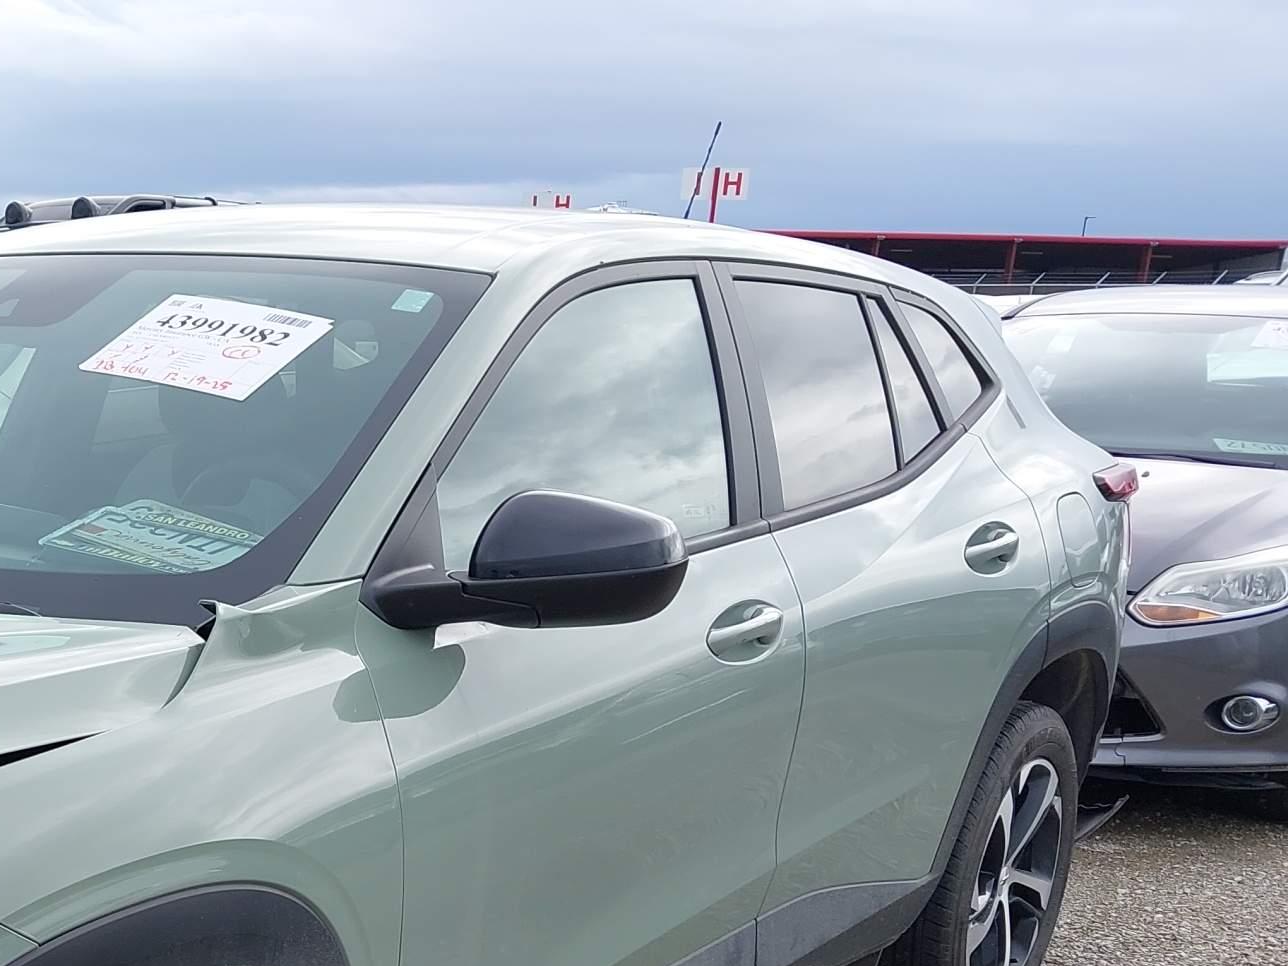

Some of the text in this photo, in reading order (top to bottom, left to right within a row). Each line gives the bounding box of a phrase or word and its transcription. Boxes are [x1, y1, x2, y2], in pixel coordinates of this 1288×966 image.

[722, 172, 743, 196] H
[156, 314, 290, 346] 43991982
[145, 513, 250, 540] SAN LEANDRO
